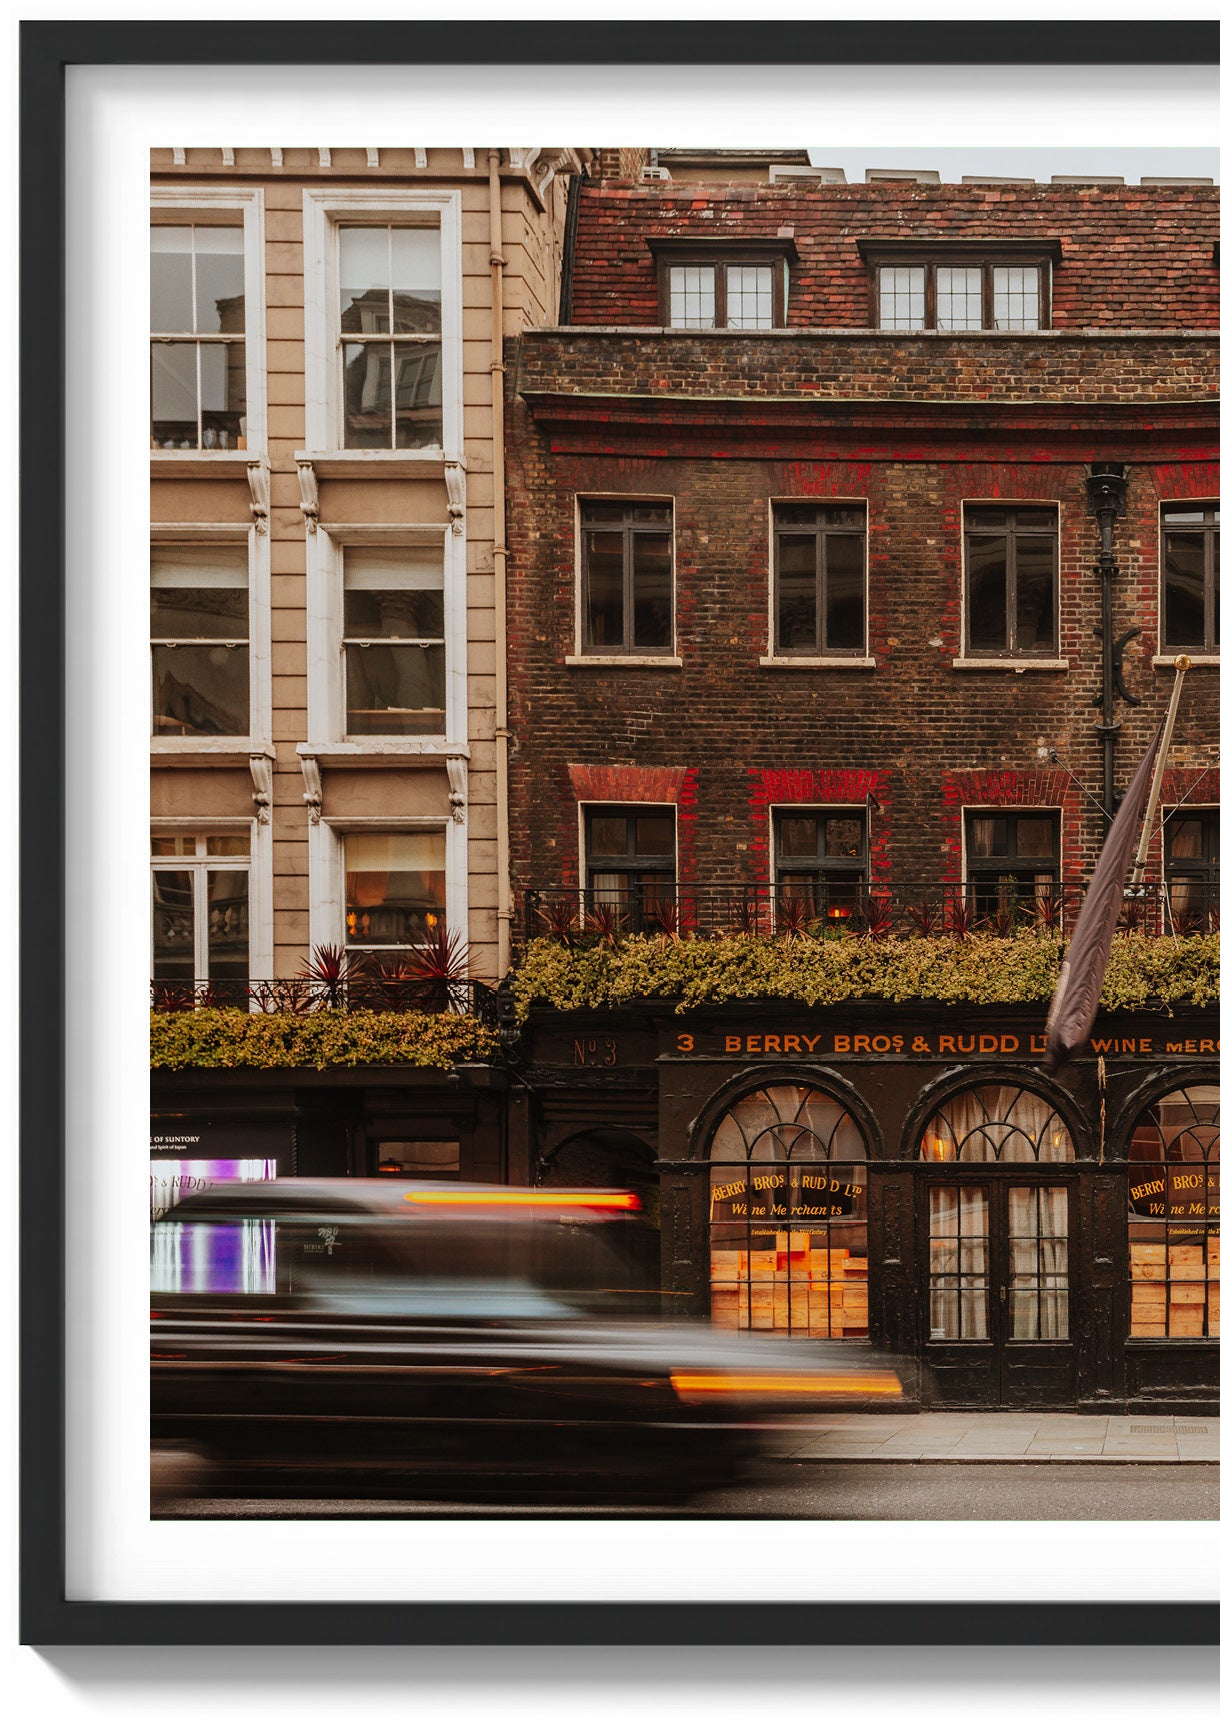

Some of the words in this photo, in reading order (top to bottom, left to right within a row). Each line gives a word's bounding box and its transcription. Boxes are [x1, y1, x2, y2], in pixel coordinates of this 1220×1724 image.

[605, 1039, 617, 1066] 3
[676, 1033, 695, 1052] 3
[725, 1035, 822, 1052] BERRY
[911, 1035, 932, 1053] &
[939, 1035, 1019, 1053] RUDD
[1090, 1038, 1153, 1053] WINE
[712, 1179, 747, 1201] BERRY
[791, 1178, 799, 1188] &
[802, 1175, 840, 1192] RUDD
[1130, 1179, 1165, 1201] BERRY
[1208, 1178, 1215, 1188] &
[732, 1203, 766, 1215] Wine
[770, 1203, 842, 1216] Merchants
[1150, 1203, 1184, 1215] Wine
